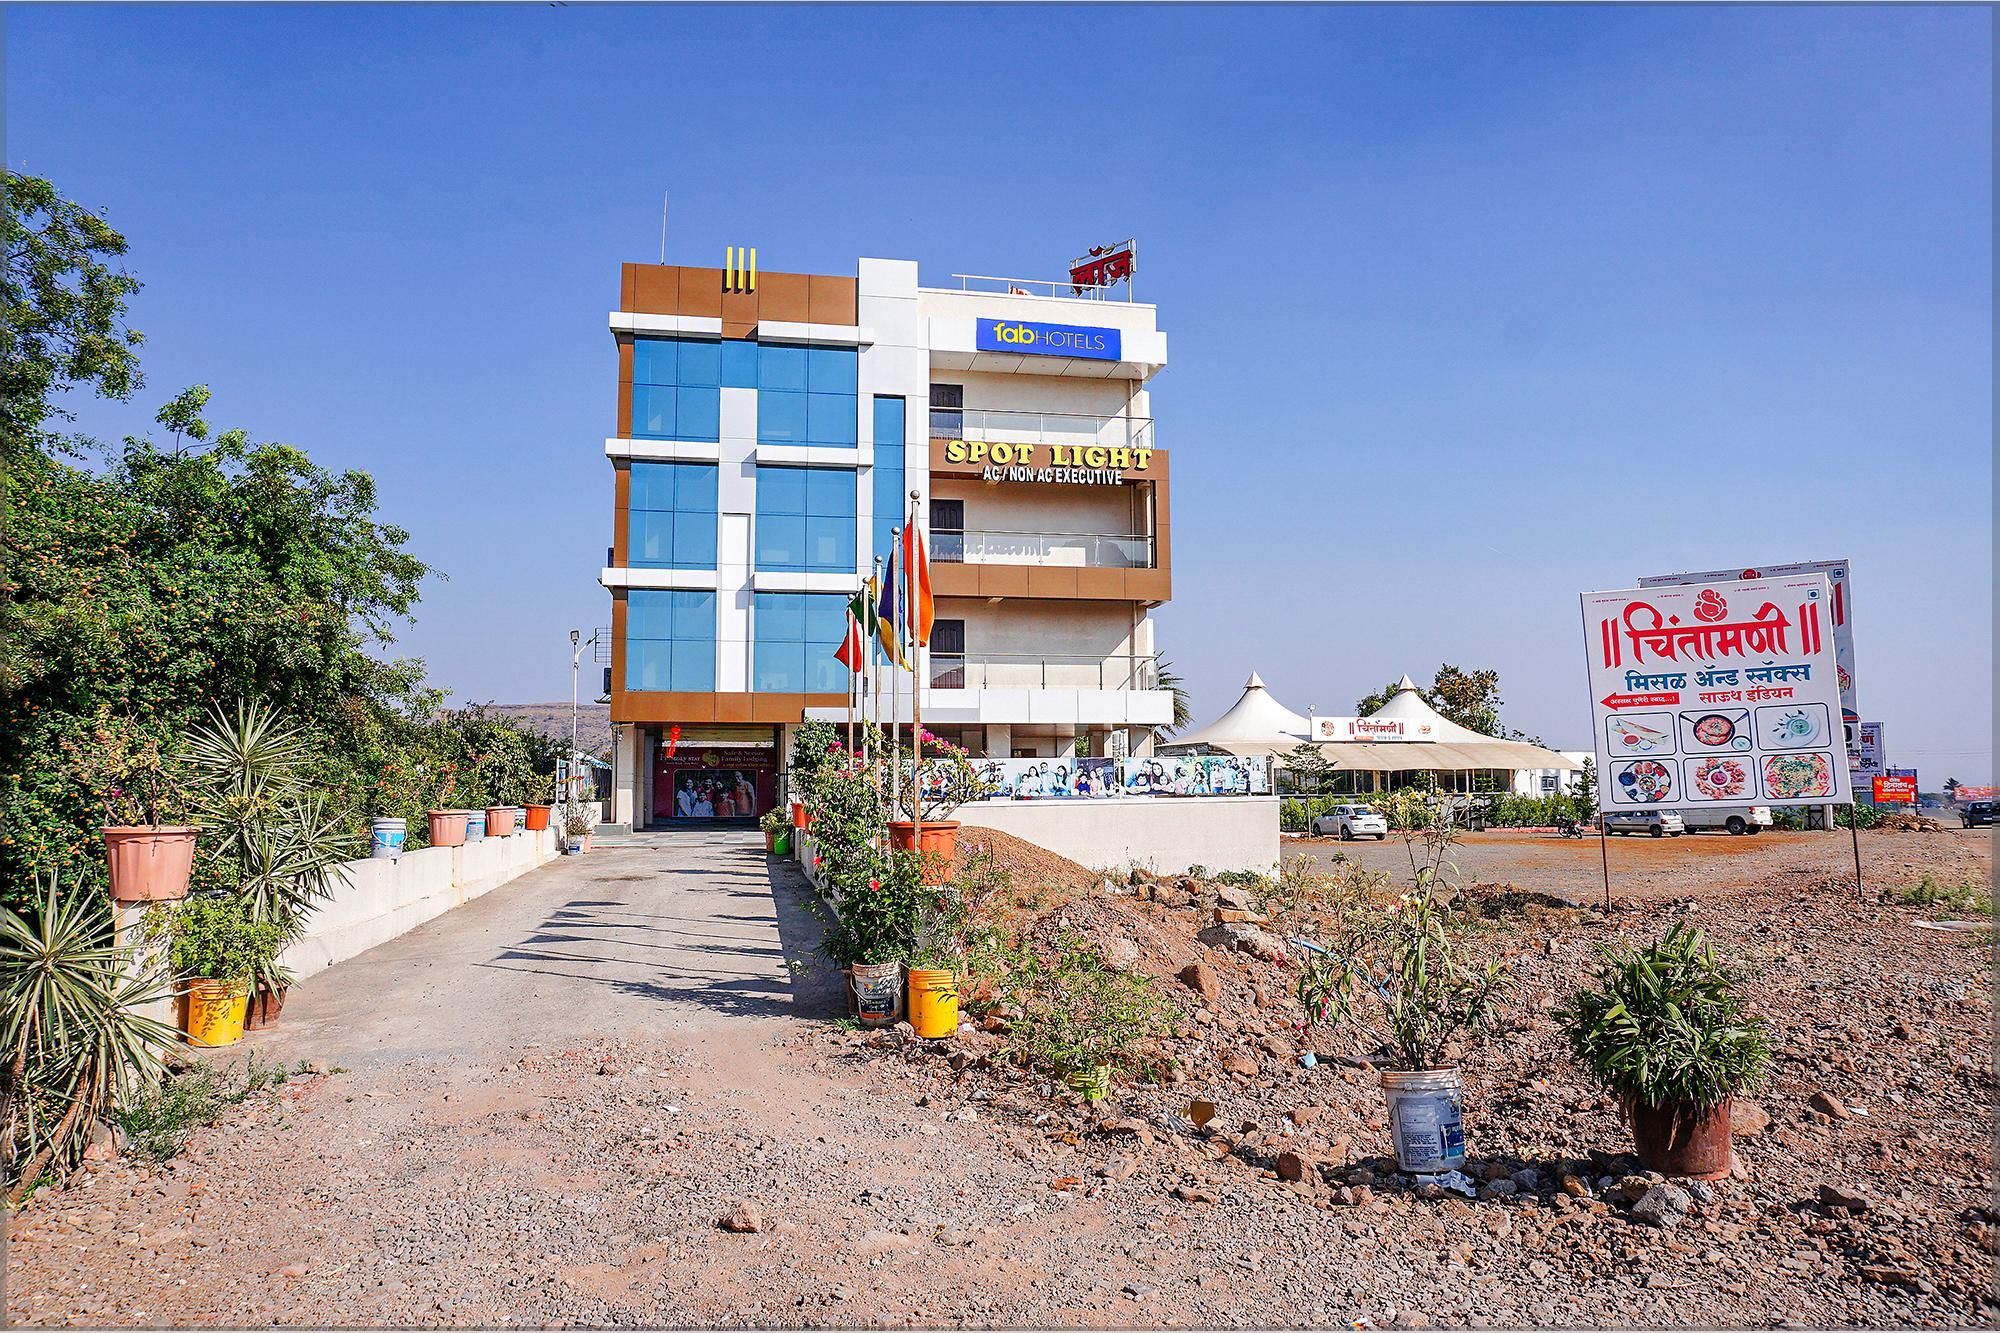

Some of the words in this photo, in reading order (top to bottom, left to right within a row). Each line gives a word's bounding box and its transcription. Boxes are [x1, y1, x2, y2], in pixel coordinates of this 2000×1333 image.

[946, 440, 1034, 464] SPOT
[1050, 445, 1152, 469] LIGHT
[1038, 468, 1053, 483] AC
[1056, 468, 1122, 485] EXECUTIVE
[1623, 601, 1792, 665] चिंतामणी
[1625, 669, 1687, 691] मिसळ
[1745, 660, 1811, 684] स्नॅक्स
[1699, 691, 1742, 704] साऊथ
[1746, 685, 1793, 702] इंडियन
